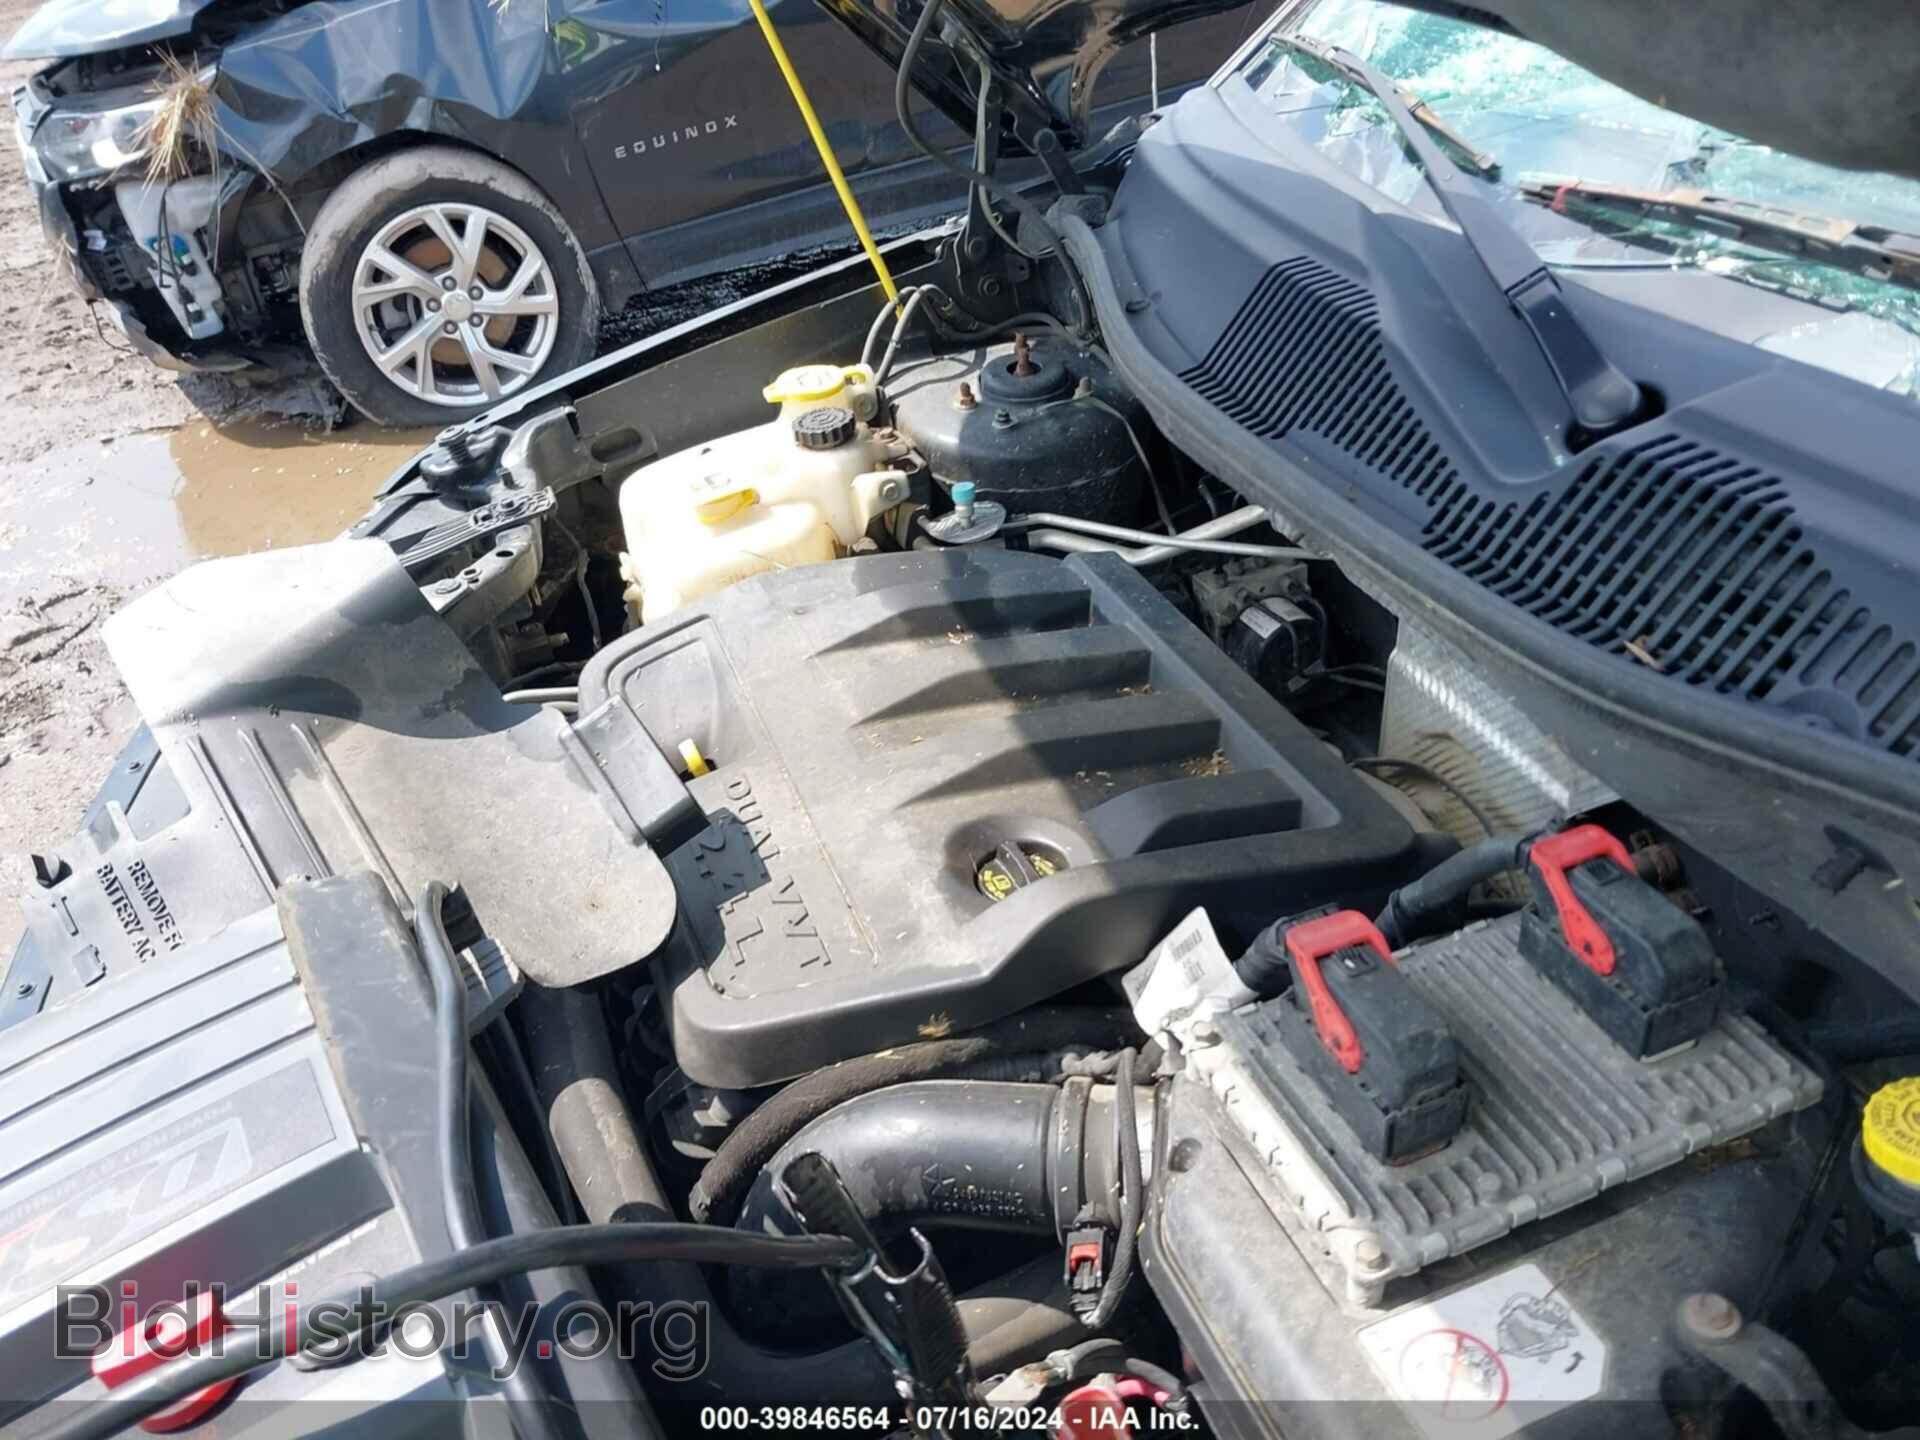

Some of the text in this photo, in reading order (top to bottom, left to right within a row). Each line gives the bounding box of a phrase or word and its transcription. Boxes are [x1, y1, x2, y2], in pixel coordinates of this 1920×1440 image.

[614, 115, 738, 159] EQUINOX
[97, 861, 144, 935] BATTERY
[128, 858, 176, 934] REMOVE
[722, 774, 832, 969] DUAL VVT
